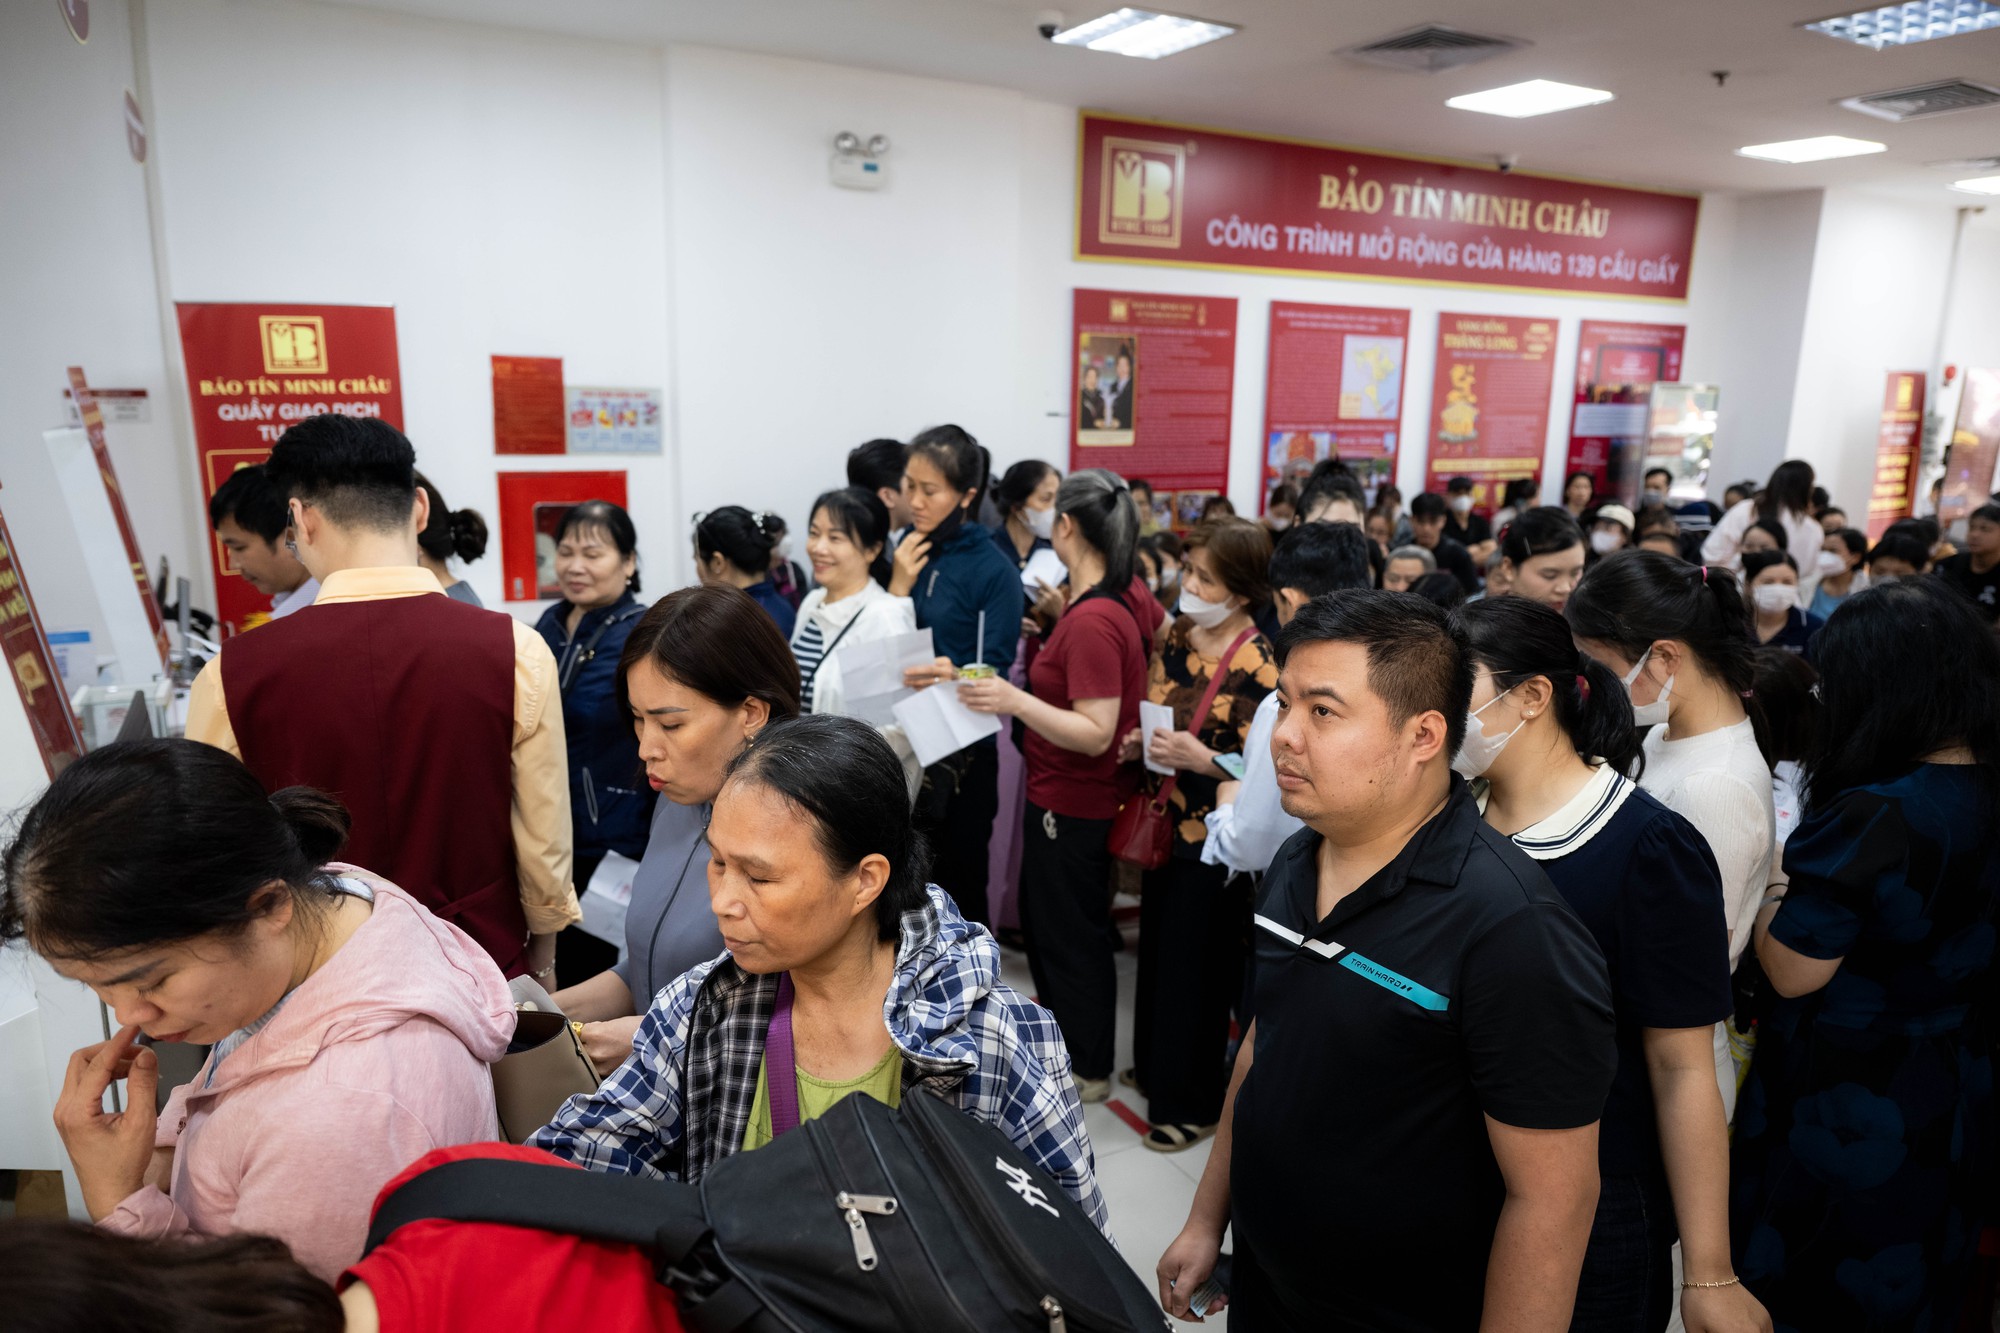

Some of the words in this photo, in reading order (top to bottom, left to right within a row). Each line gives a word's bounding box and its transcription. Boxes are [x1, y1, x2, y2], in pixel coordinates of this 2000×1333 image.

[1318, 165, 1384, 214] BẢO
[1390, 177, 1447, 220] TÍN
[1449, 190, 1530, 230] MINH
[1534, 198, 1611, 239] CHÂU
[1206, 214, 1278, 251] CÔNG
[1283, 221, 1354, 257] TRÌNH
[1358, 225, 1395, 260] MỞ
[1397, 232, 1459, 268] RỘNG
[1462, 236, 1504, 270] CỬA
[1507, 243, 1562, 276] HÀNG
[1566, 253, 1597, 278] 139
[1599, 249, 1637, 282] CẦU
[1638, 253, 1680, 284] GIẤY
[200, 376, 243, 396] BẢO
[245, 376, 280, 395] TÍN
[283, 379, 335, 395] MINH
[338, 375, 391, 395] CHÂU
[217, 397, 275, 421] QUẦY
[278, 402, 329, 420] GIAO
[1351, 958, 1375, 974] TRAIN
[1375, 970, 1402, 987] HARD
